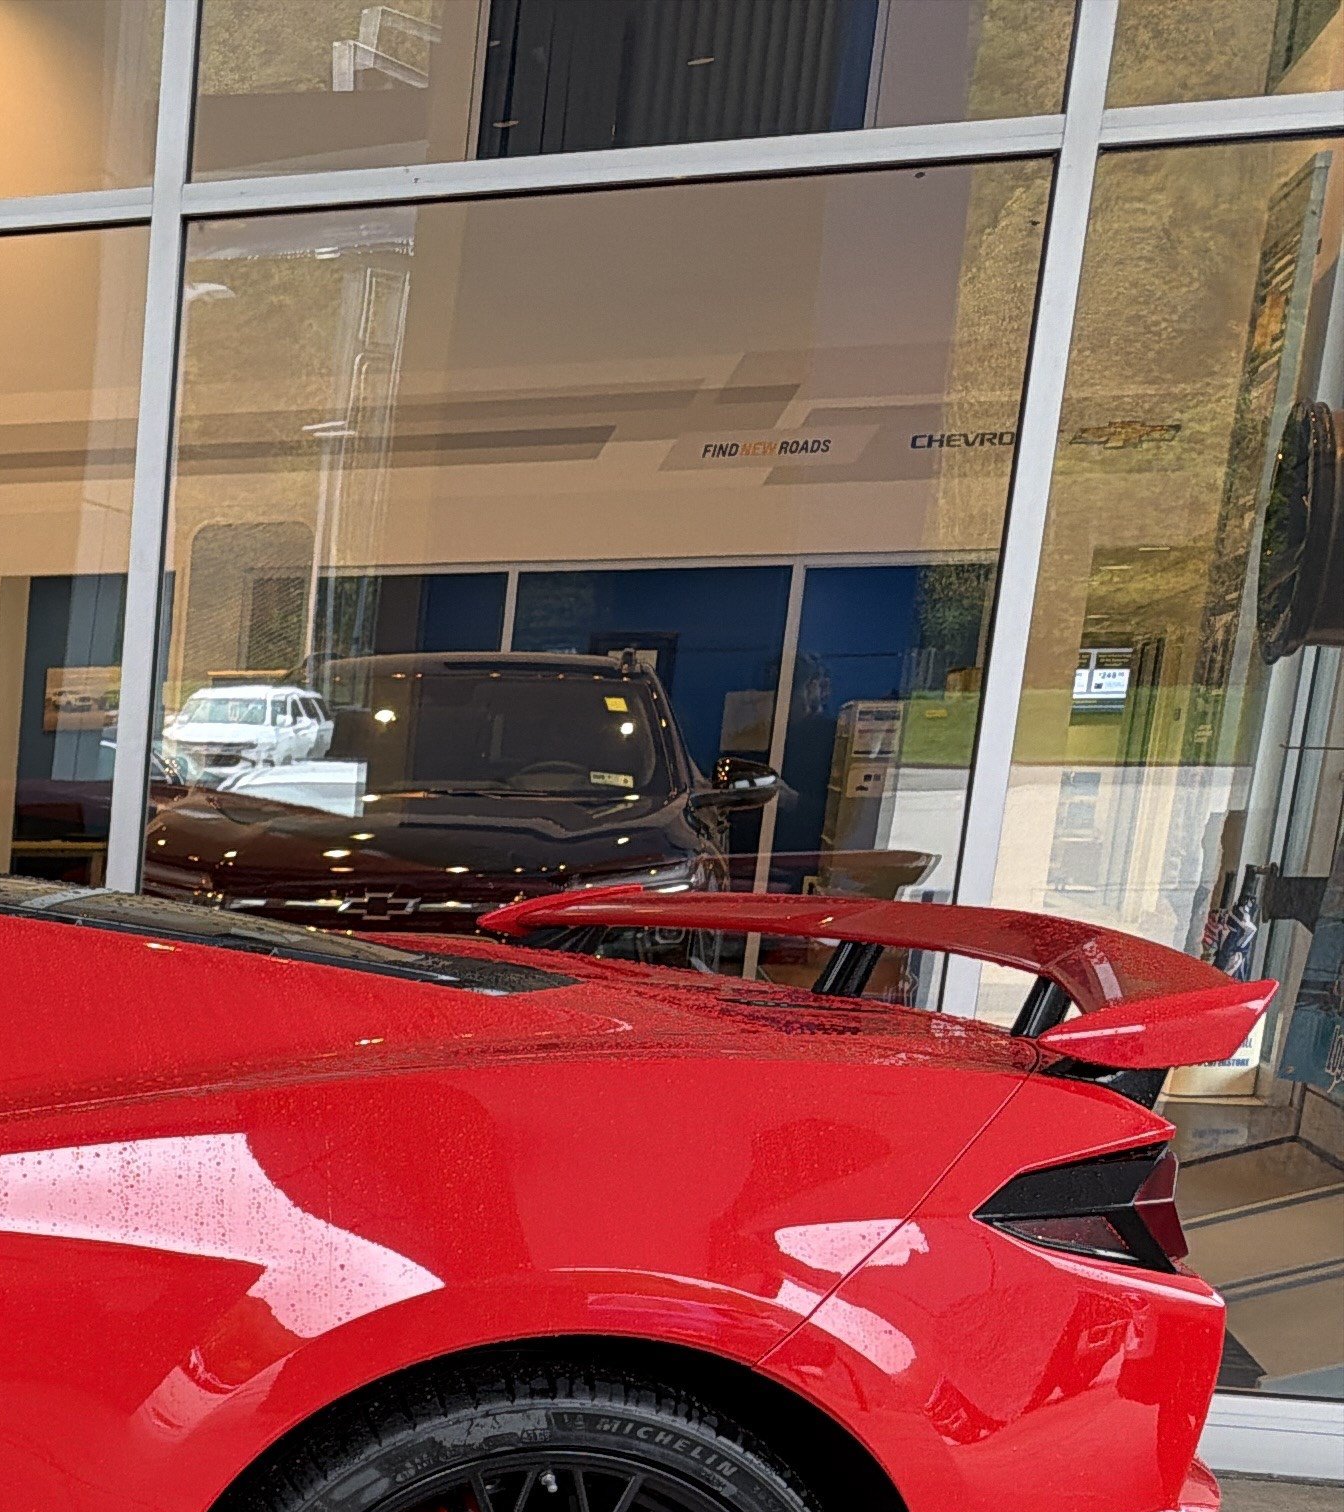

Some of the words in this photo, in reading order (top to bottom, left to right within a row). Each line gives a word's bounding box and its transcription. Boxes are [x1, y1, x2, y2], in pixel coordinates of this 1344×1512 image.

[701, 442, 739, 458] FIND
[739, 441, 778, 456] NEW
[778, 439, 832, 456] ROADS
[910, 431, 1017, 449] CHEVRO
[596, 1416, 739, 1478] MICHELIN
